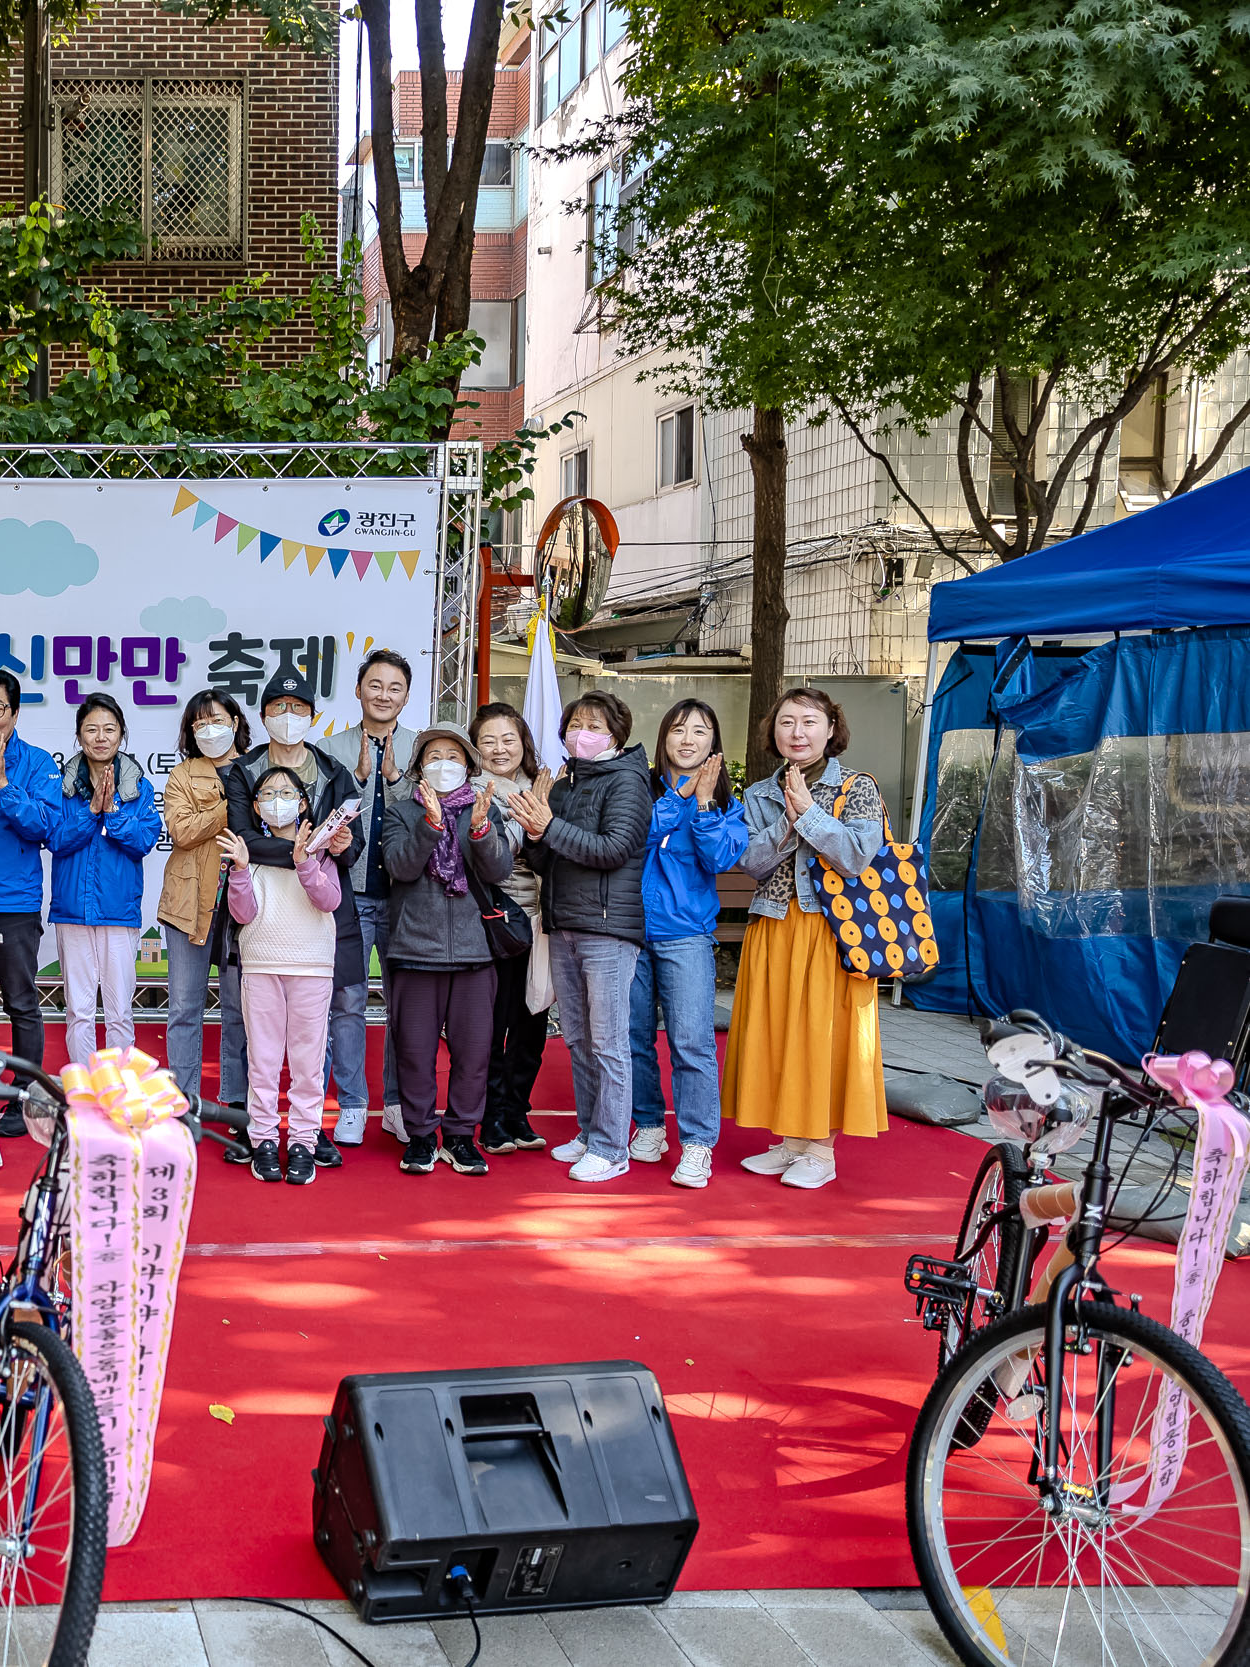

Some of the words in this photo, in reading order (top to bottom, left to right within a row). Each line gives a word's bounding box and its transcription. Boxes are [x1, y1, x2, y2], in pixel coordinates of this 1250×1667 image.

[356, 511, 416, 529] 광진구
[354, 528, 416, 537] GWANGJIN-GU
[208, 631, 336, 706] 축제
